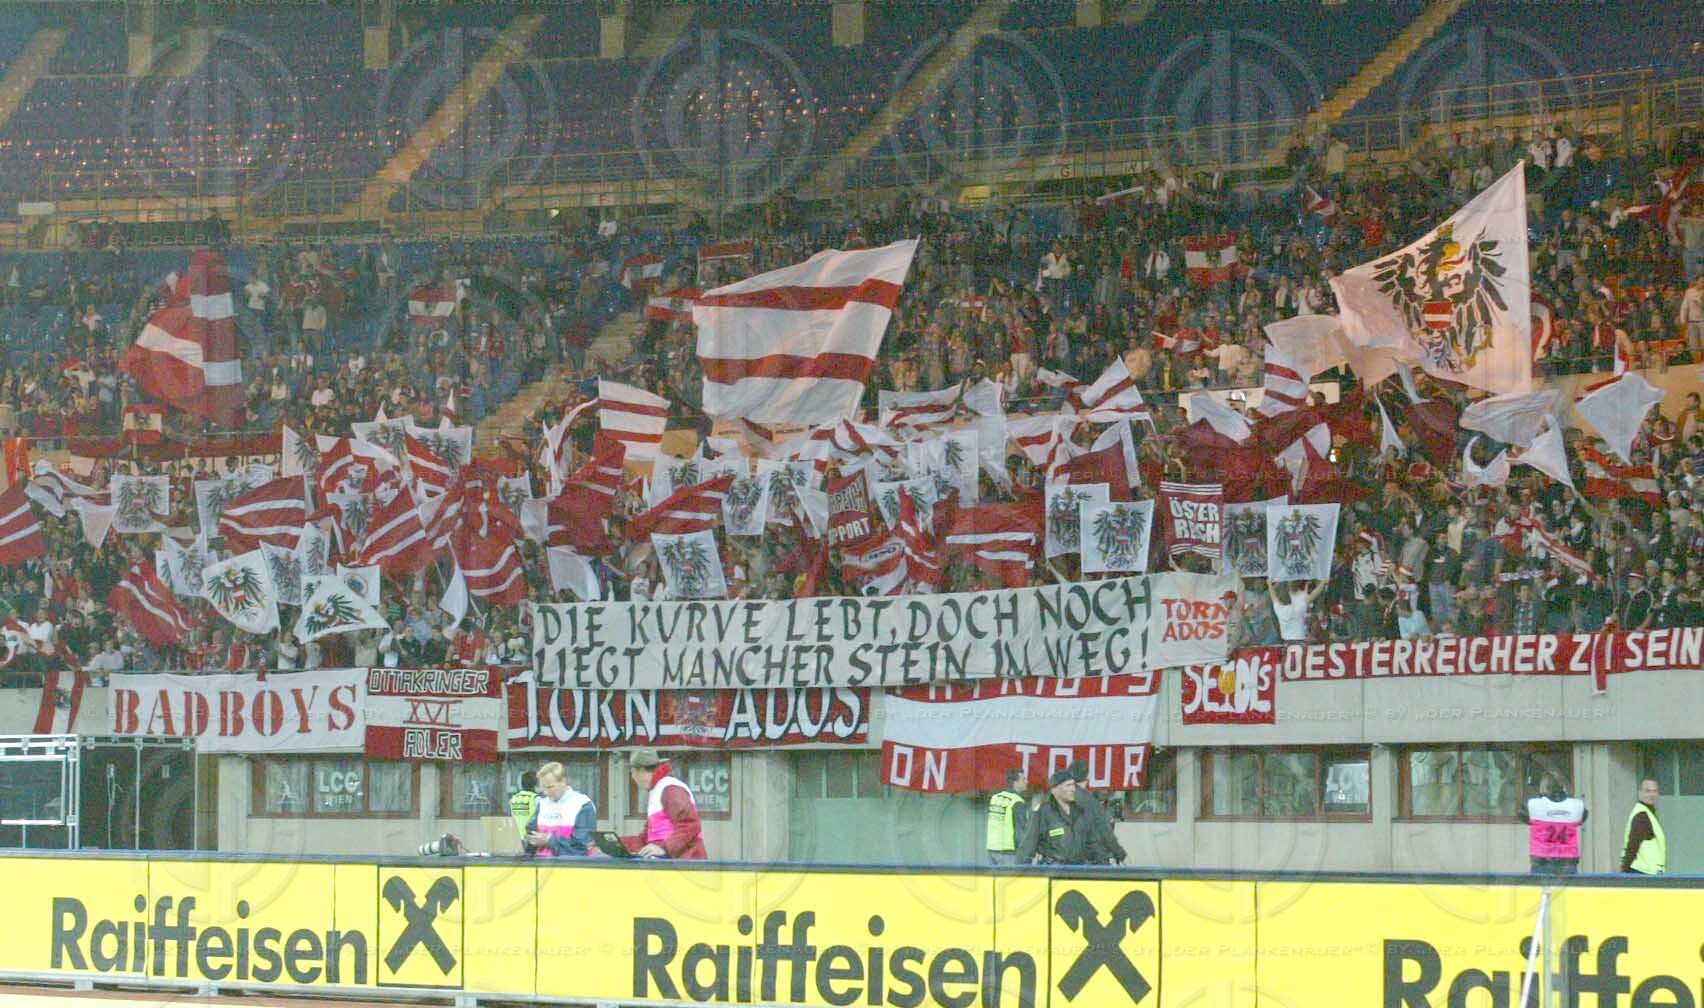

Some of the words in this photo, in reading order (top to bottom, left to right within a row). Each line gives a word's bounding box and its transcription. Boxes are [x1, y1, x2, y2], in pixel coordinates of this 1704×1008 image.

[1169, 497, 1220, 522] ÖSTER
[537, 604, 606, 647] DIE
[627, 602, 766, 644] KURVE
[906, 592, 1018, 642] DOCH
[1034, 575, 1150, 632] NOCH
[1161, 620, 1226, 643] ADOS
[534, 646, 645, 687] LIEGT
[663, 643, 834, 687] MANCHER
[848, 641, 972, 687] STEIN
[992, 638, 1032, 678] IM
[1043, 622, 1150, 678] WEG!
[1283, 634, 1556, 680] OESTERREICHER
[368, 668, 490, 695] OTTAKRINGER
[403, 697, 464, 727] XVI
[403, 728, 463, 760] ADLER
[689, 769, 729, 793] LCC
[889, 744, 948, 790] ON
[50, 894, 368, 985] Raiffeisen
[632, 910, 1037, 1008] Raiffeisen
